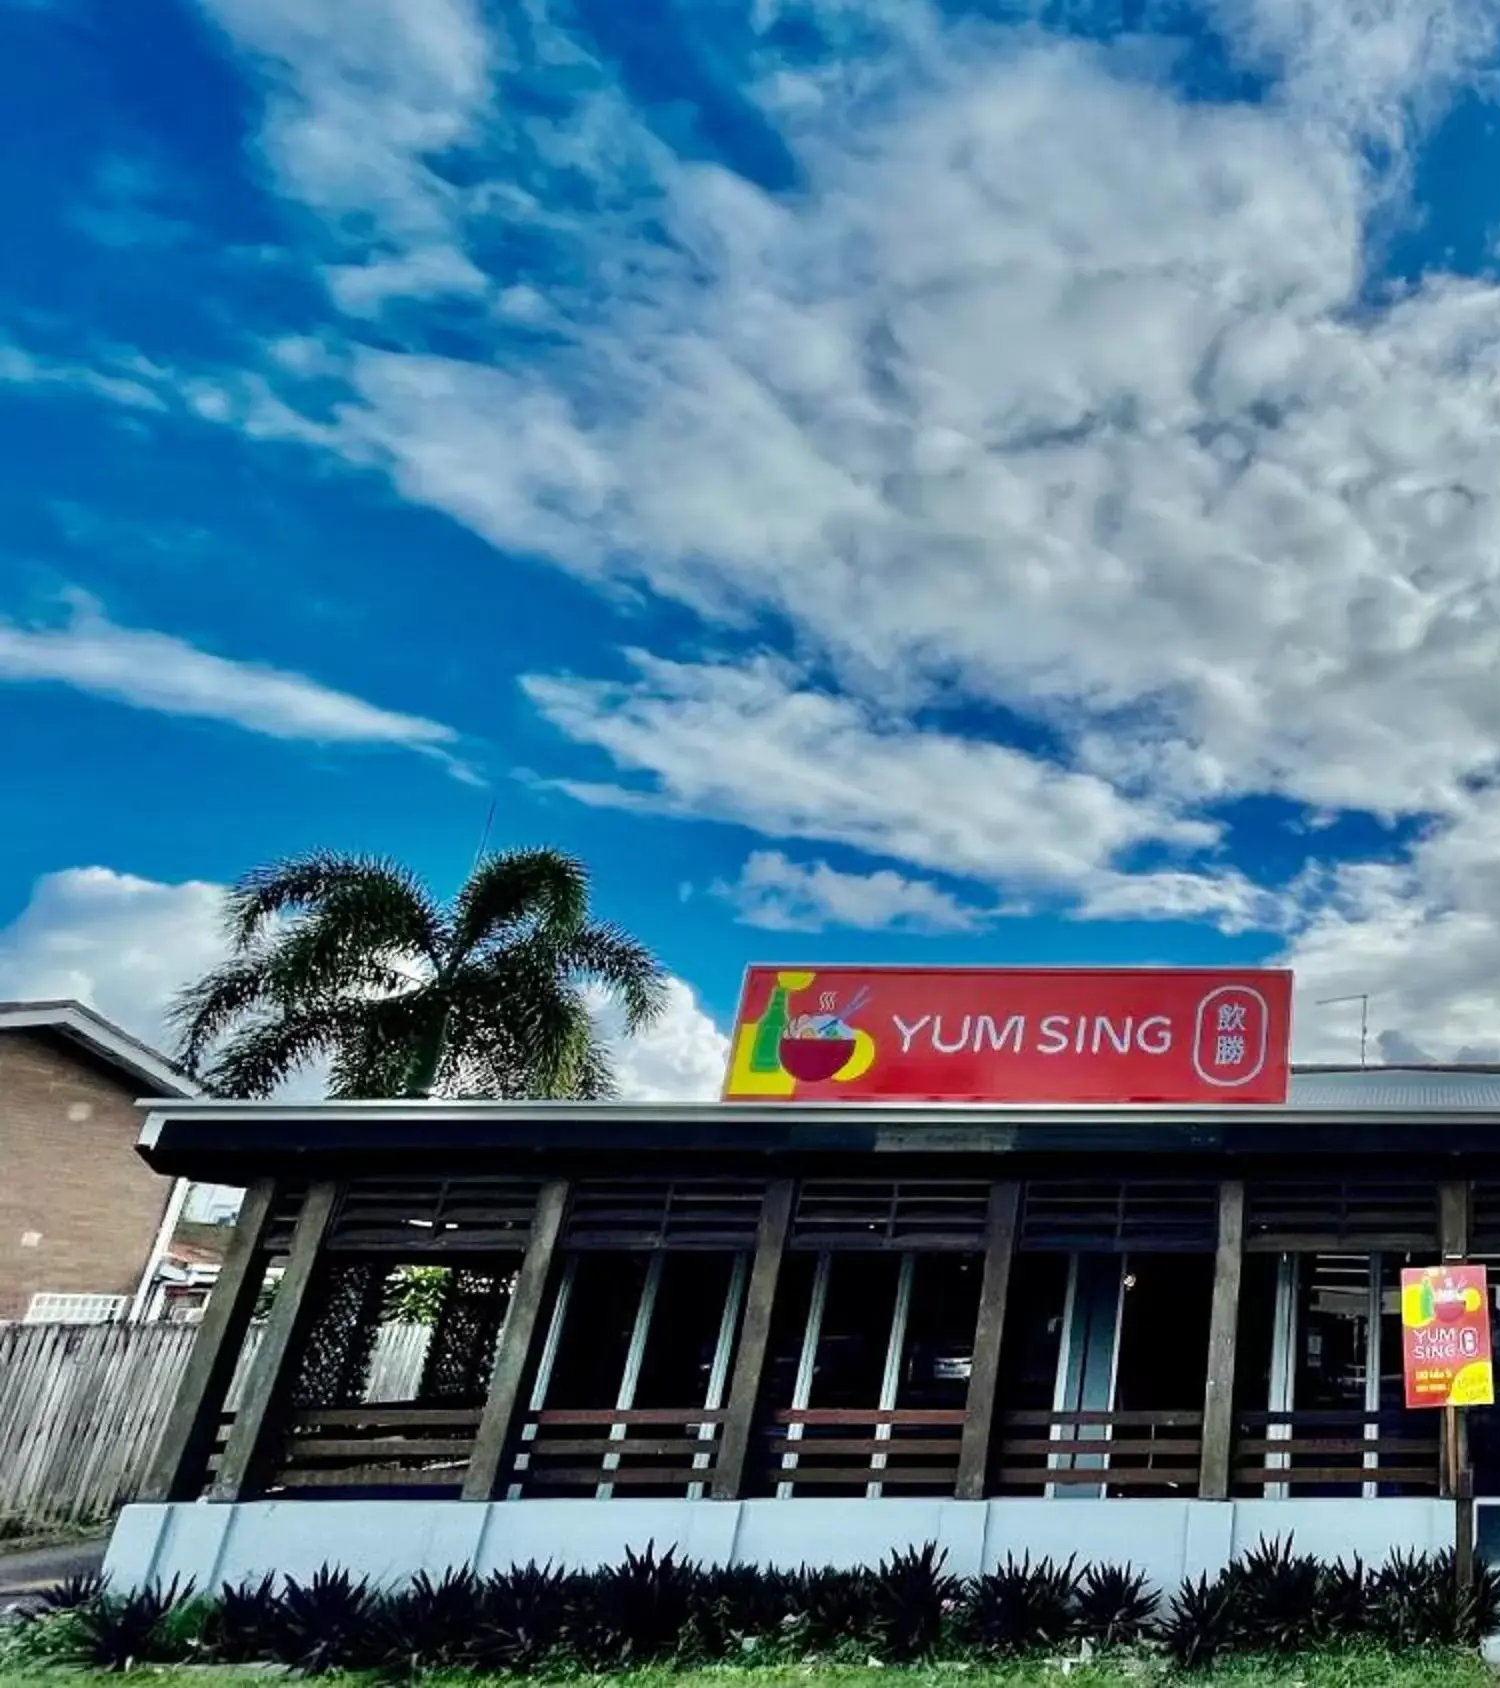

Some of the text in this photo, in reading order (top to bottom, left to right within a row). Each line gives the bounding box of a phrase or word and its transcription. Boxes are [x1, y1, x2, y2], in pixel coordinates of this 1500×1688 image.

[892, 1014, 1172, 1055] YUM SING
[1412, 1327, 1456, 1345] YUM
[1413, 1344, 1456, 1359] SING
